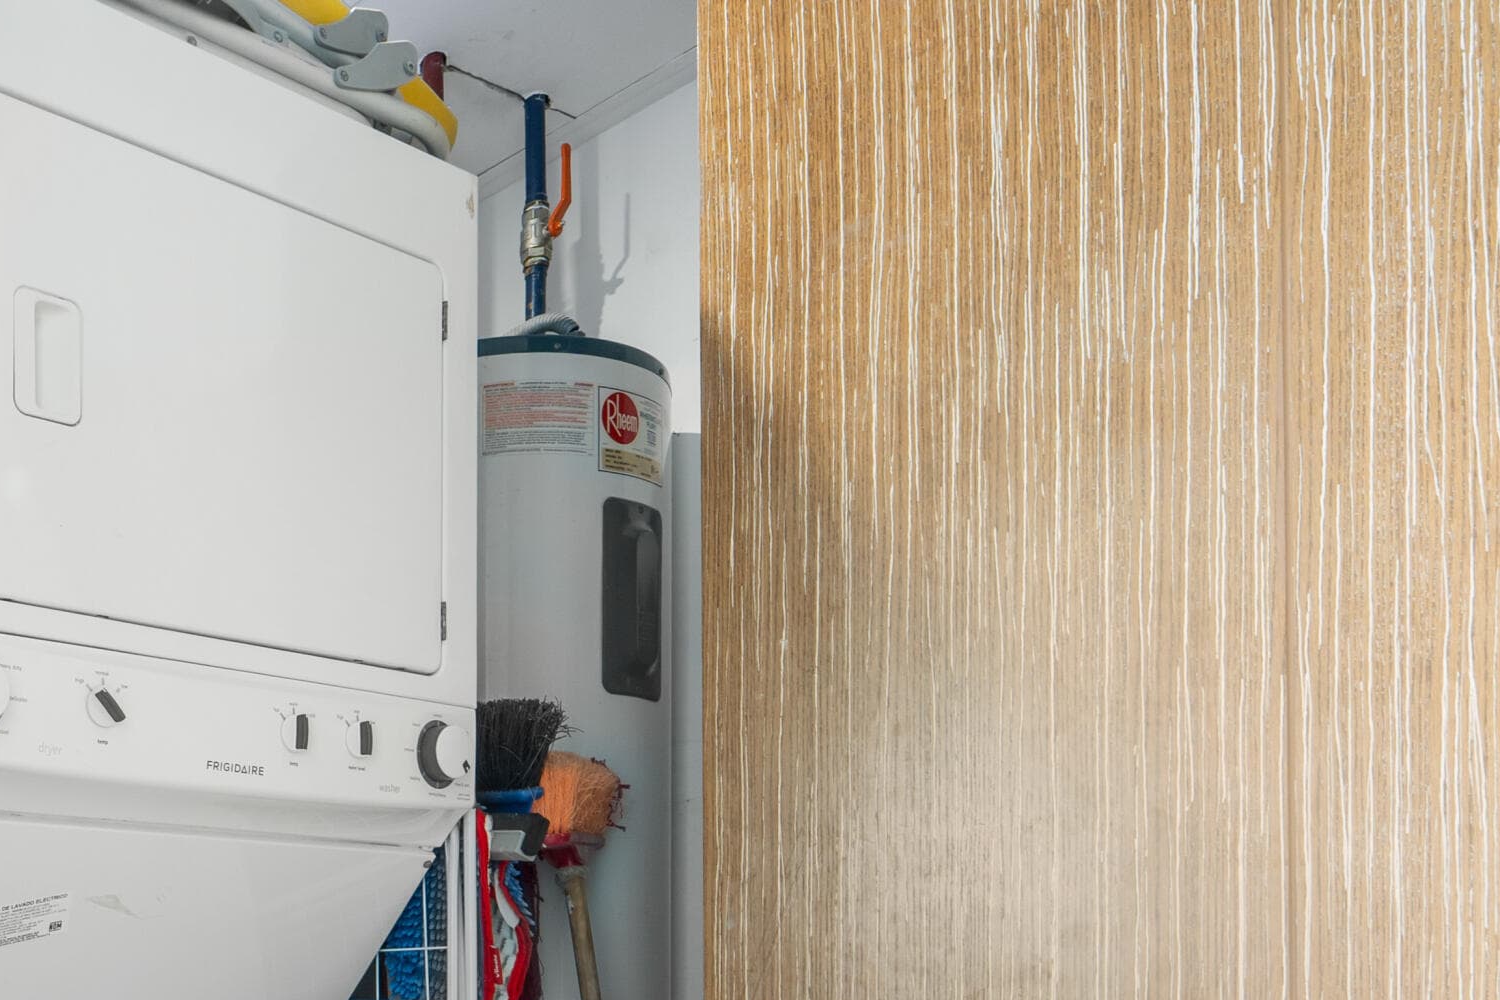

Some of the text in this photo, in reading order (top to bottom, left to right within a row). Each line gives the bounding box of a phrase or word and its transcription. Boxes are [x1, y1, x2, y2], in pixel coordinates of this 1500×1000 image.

[605, 394, 639, 437] Rheem
[38, 741, 62, 756] dryer
[206, 760, 264, 776] FRIGIDAIRE
